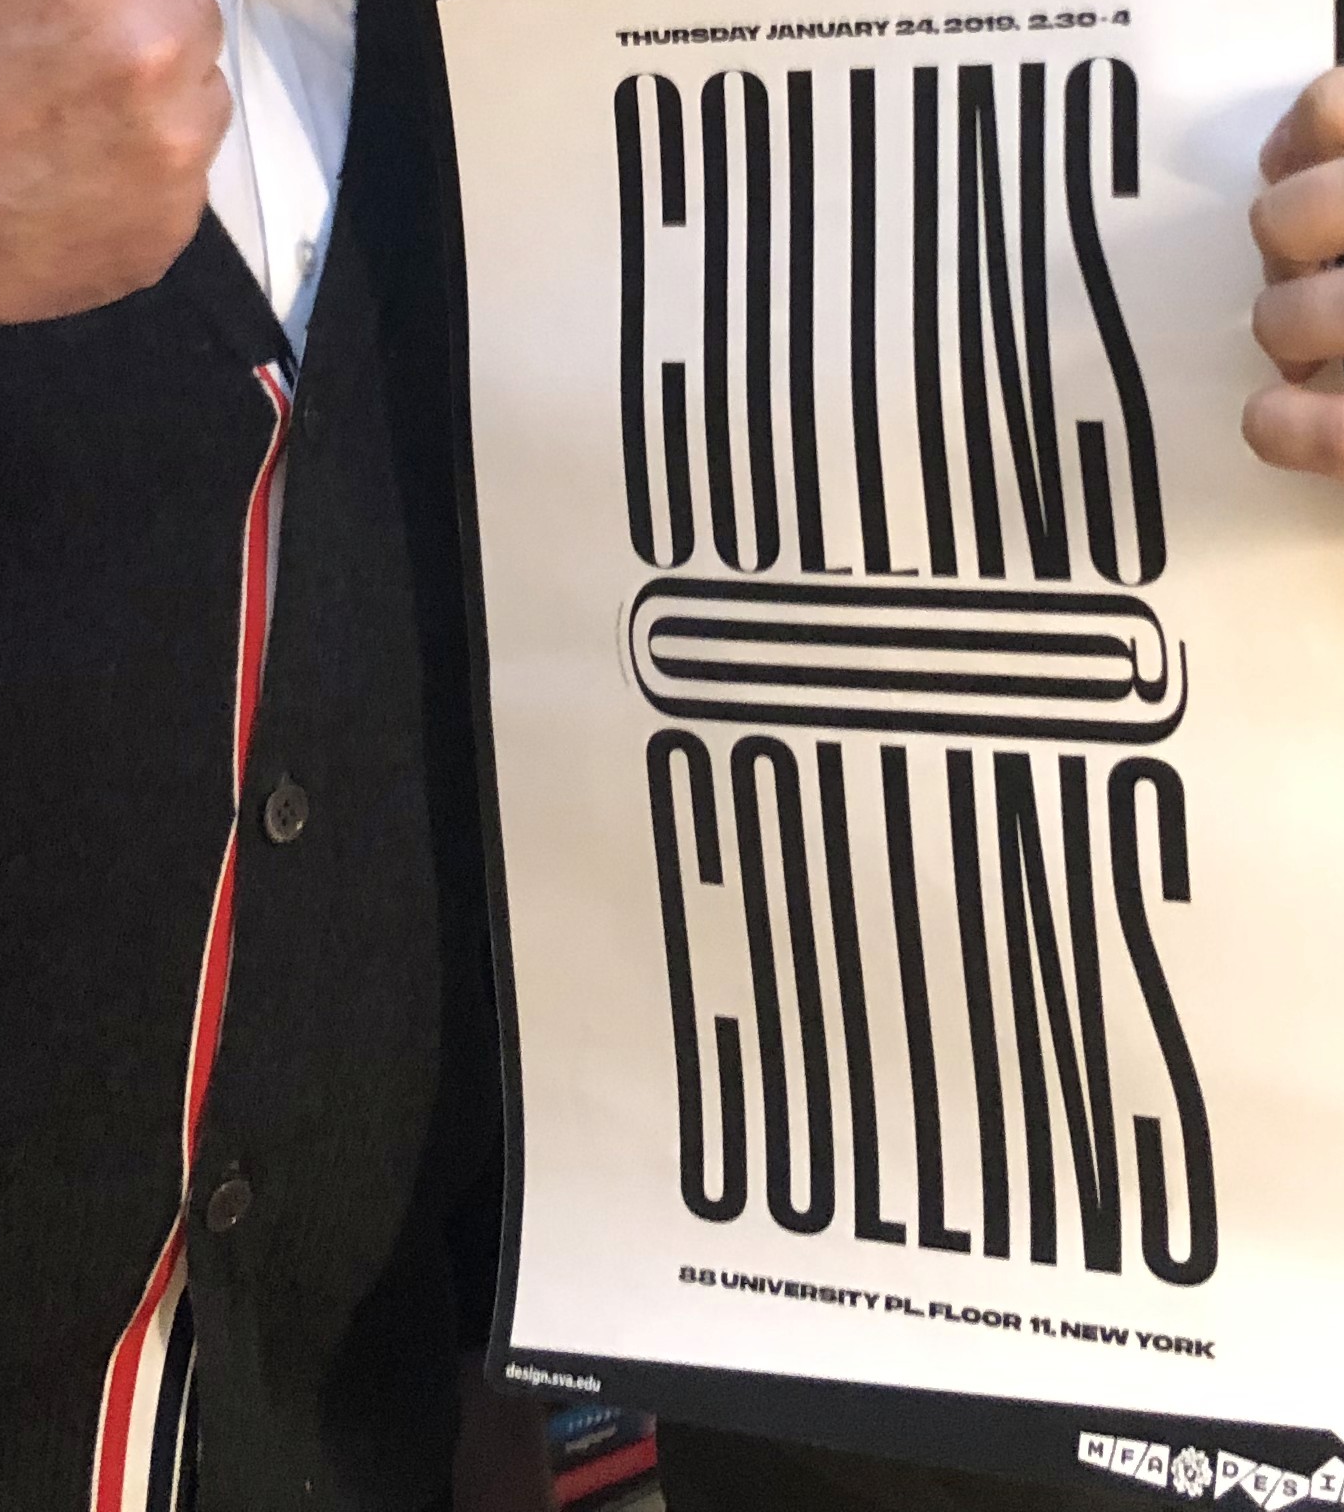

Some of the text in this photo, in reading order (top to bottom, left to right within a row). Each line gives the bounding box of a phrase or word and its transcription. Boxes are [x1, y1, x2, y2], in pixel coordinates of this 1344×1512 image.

[616, 26, 760, 46] THURSDAY
[766, 20, 889, 41] JANUARY
[614, 57, 1167, 586] COLLINS
[646, 728, 1218, 1287] COLLINS
[678, 1265, 717, 1285] 88
[720, 1272, 880, 1310] UNIVERSITY
[929, 1300, 1022, 1332] FLOOR
[1060, 1320, 1129, 1346] NEW
[1135, 1330, 1216, 1360] YORK
[504, 1361, 602, 1393] design.sva.edu
[1087, 1440, 1163, 1473] MFA
